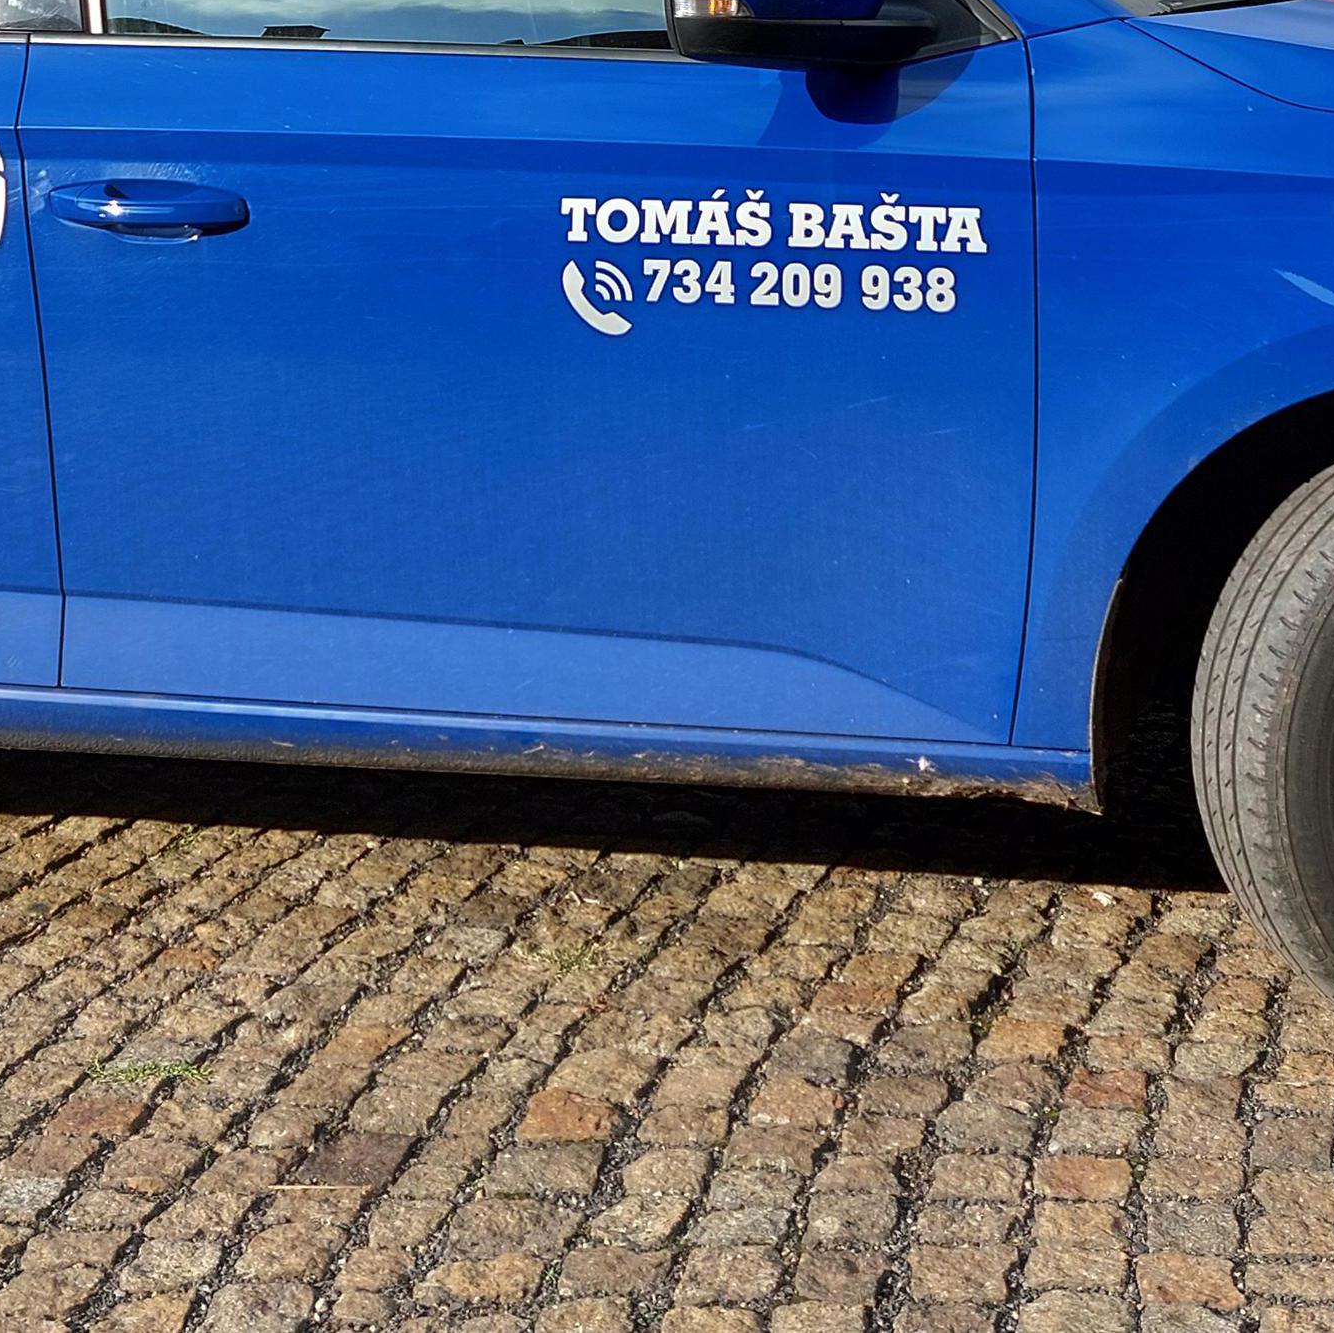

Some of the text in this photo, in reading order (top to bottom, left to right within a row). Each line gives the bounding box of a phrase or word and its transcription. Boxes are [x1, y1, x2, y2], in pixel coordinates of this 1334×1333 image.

[561, 189, 987, 253] TOMÁŠ BAŠTA
[643, 259, 956, 313] 734 209 938
